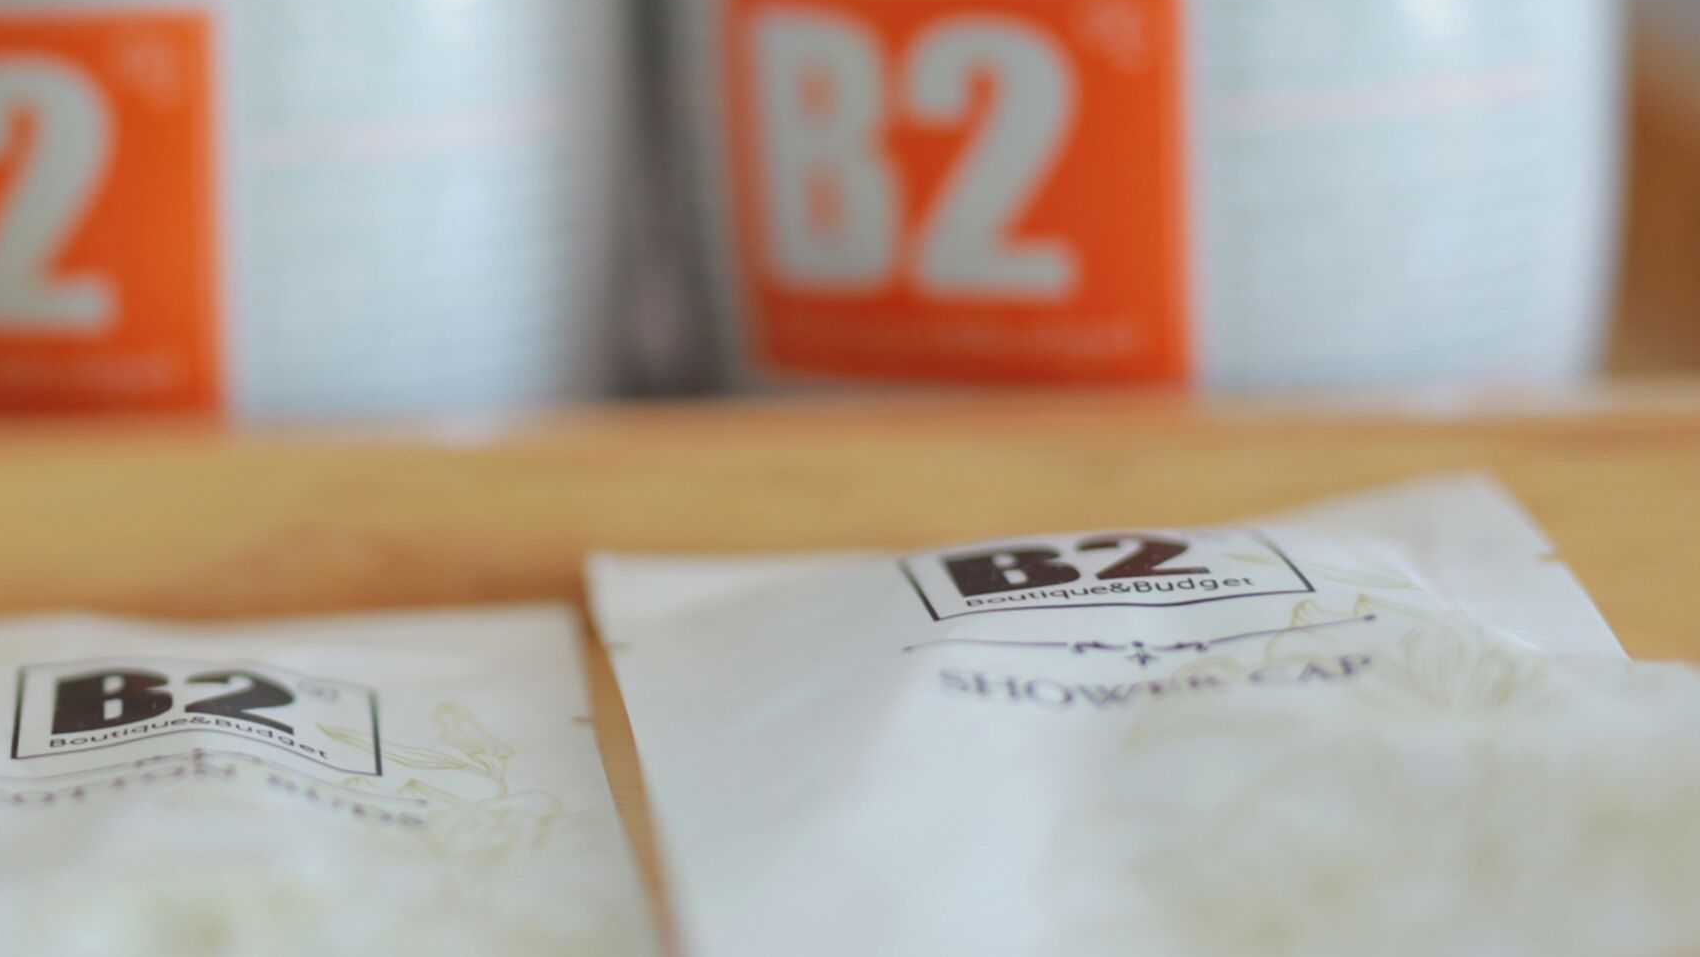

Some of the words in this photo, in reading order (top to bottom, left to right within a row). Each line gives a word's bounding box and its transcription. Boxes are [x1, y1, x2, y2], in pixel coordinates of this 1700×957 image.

[757, 10, 1079, 299] B2
[941, 535, 1211, 597] B2
[965, 576, 1257, 607] Boutique&Budget
[51, 668, 295, 736] B2
[48, 715, 330, 760] Boutique&Budget
